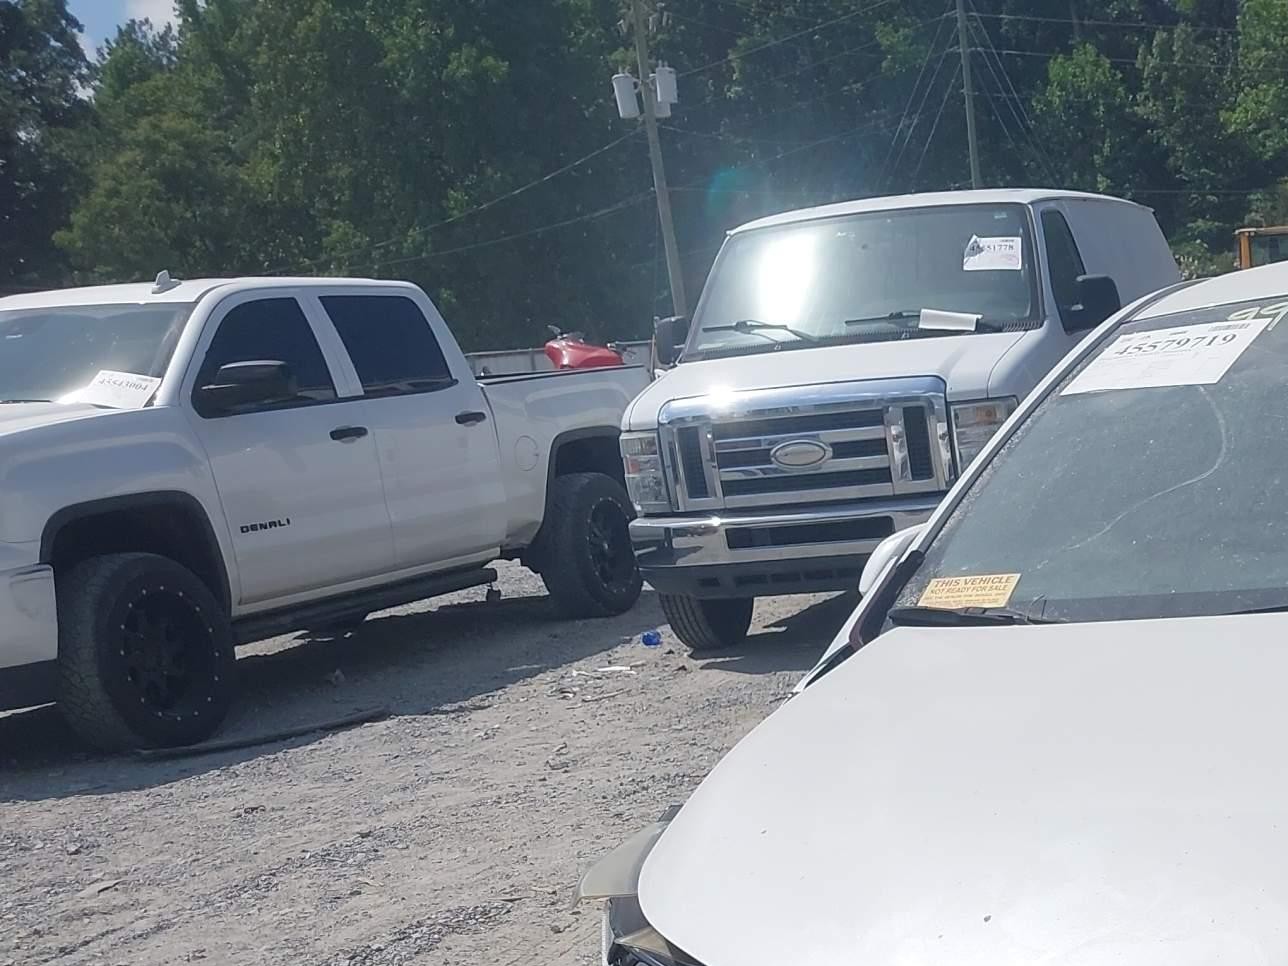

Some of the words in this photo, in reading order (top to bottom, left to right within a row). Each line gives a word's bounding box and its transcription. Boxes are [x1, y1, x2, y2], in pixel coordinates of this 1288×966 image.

[1114, 333, 1238, 356] 45579719
[240, 518, 290, 533] DENALI
[934, 579, 960, 588] THIS
[964, 576, 1013, 585] VEHICLE
